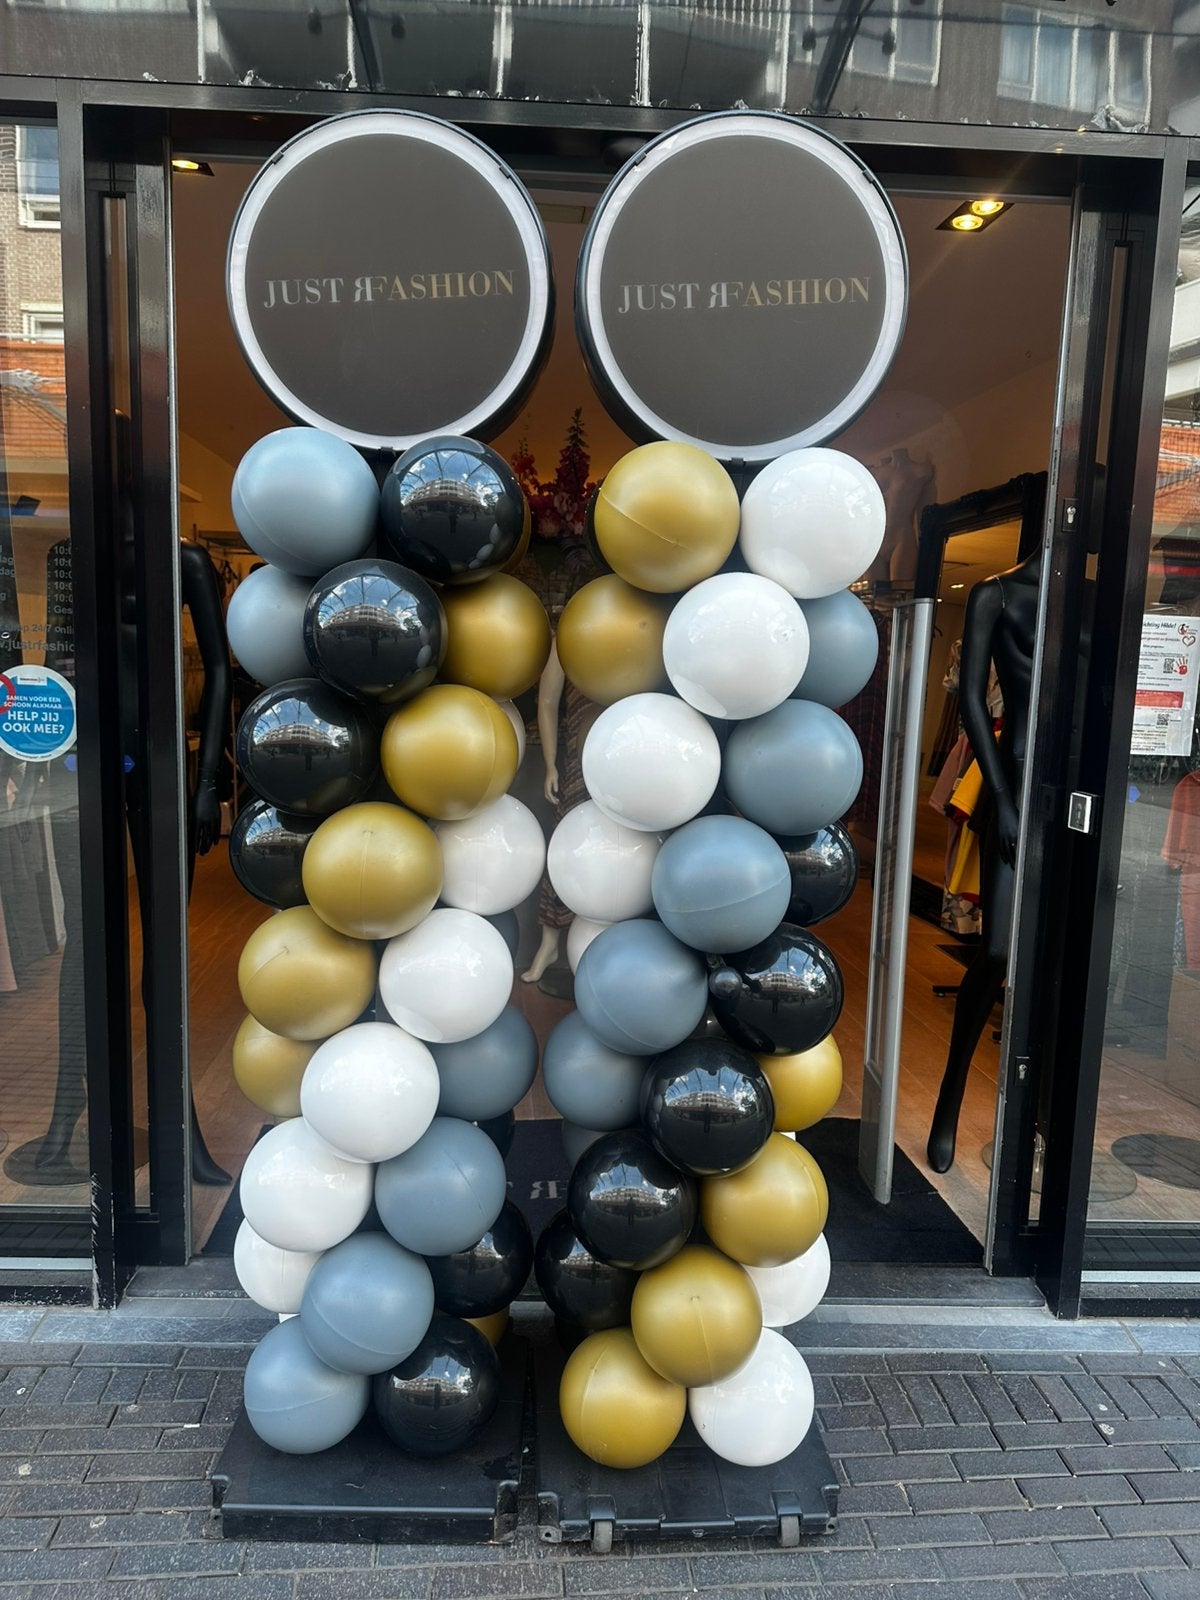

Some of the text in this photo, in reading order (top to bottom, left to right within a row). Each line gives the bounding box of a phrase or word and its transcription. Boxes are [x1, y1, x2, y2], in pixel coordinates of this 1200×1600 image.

[264, 277, 344, 308] JUST
[618, 283, 700, 314] JUST
[7, 710, 60, 722] HELP JIJ
[2, 722, 65, 734] OOK MEE?
